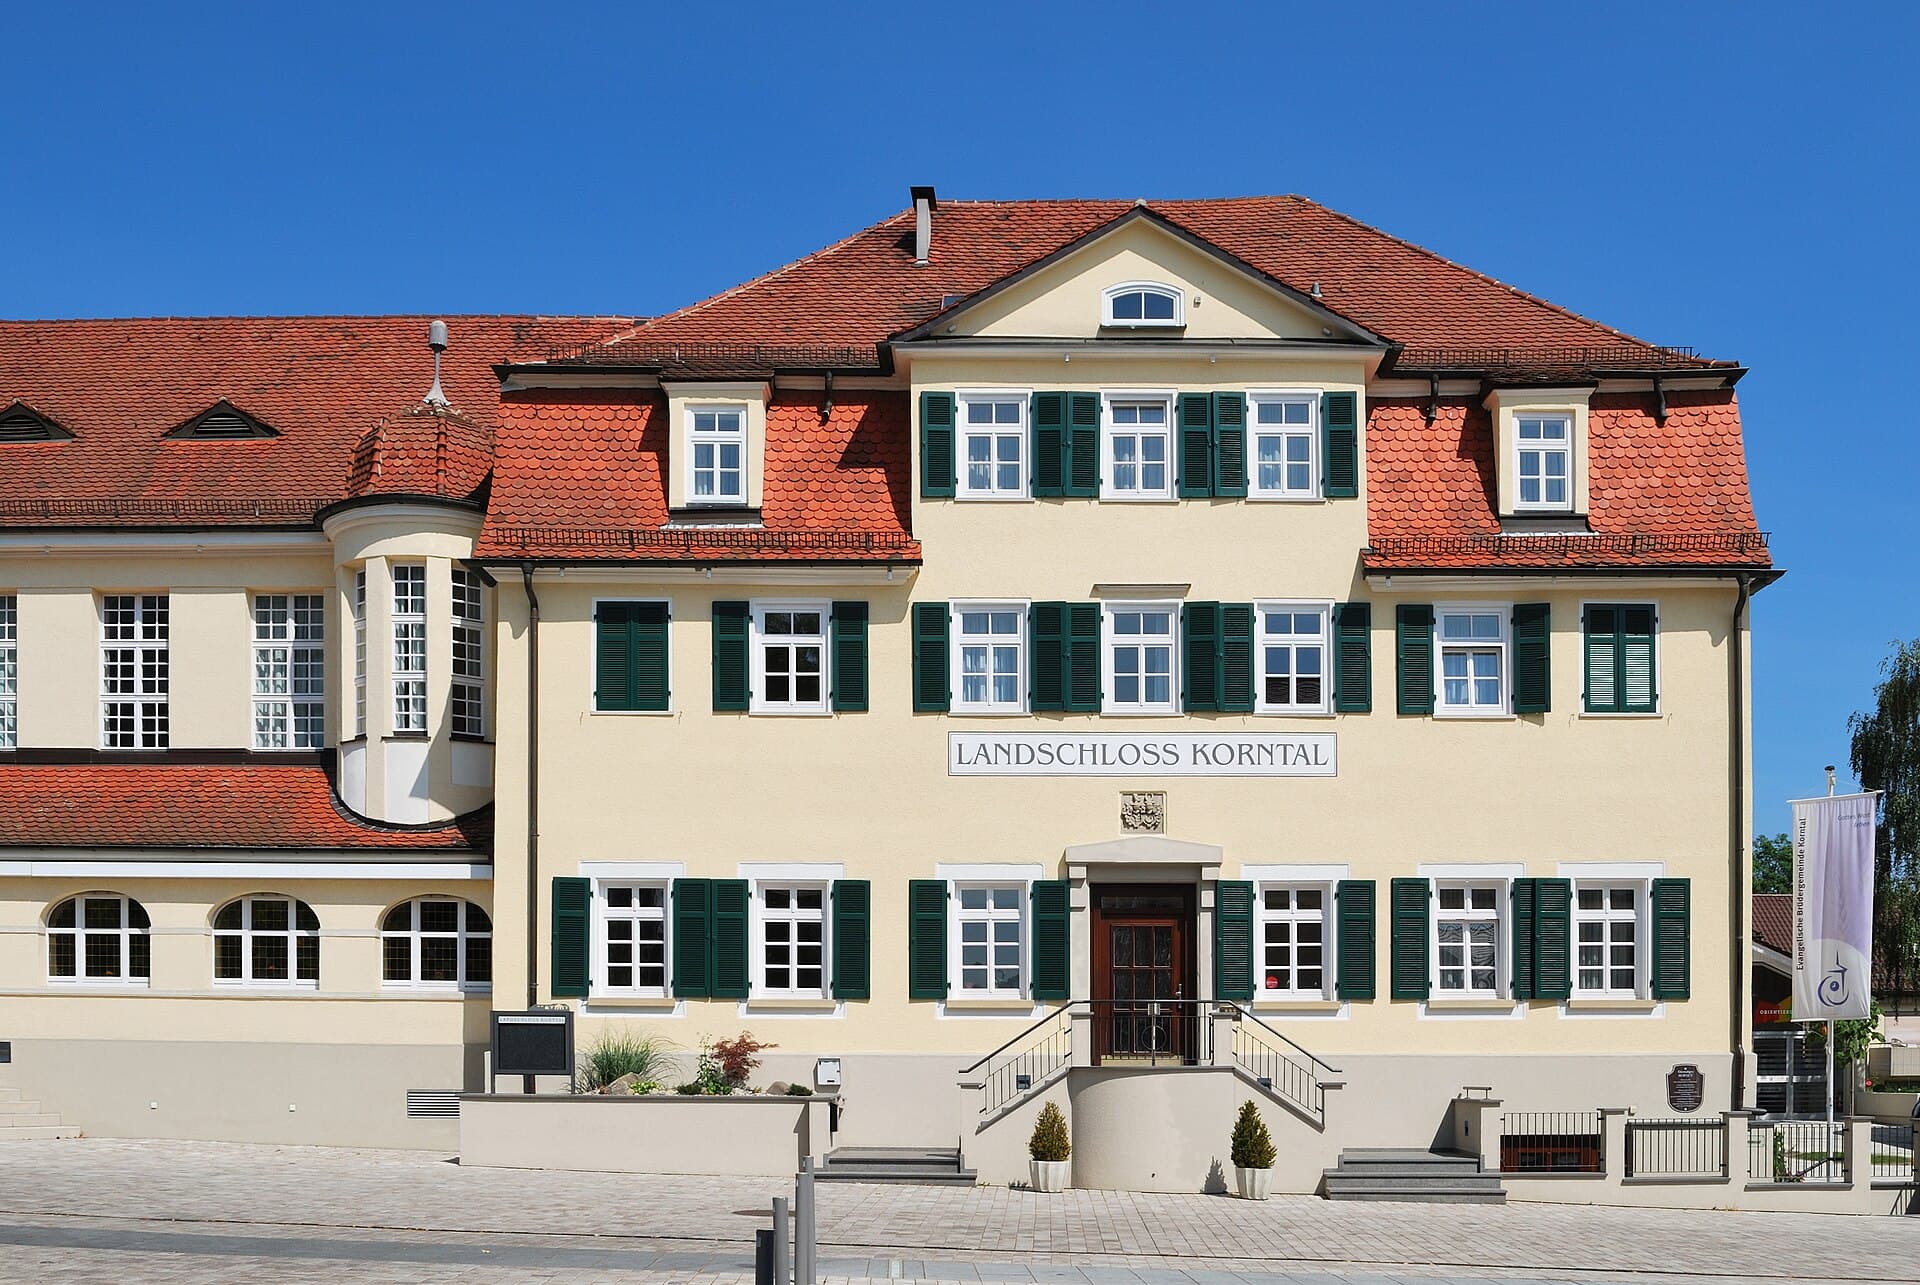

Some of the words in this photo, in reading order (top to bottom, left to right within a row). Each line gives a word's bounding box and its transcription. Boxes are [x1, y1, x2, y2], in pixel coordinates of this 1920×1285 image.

[956, 742, 1180, 766] LANDSCHLOSS
[1191, 742, 1329, 766] KORNTAL
[1797, 817, 1807, 847] Korntal
[1796, 849, 1806, 916] Brüdergemeinde
[1796, 917, 1806, 971] Evangelische
